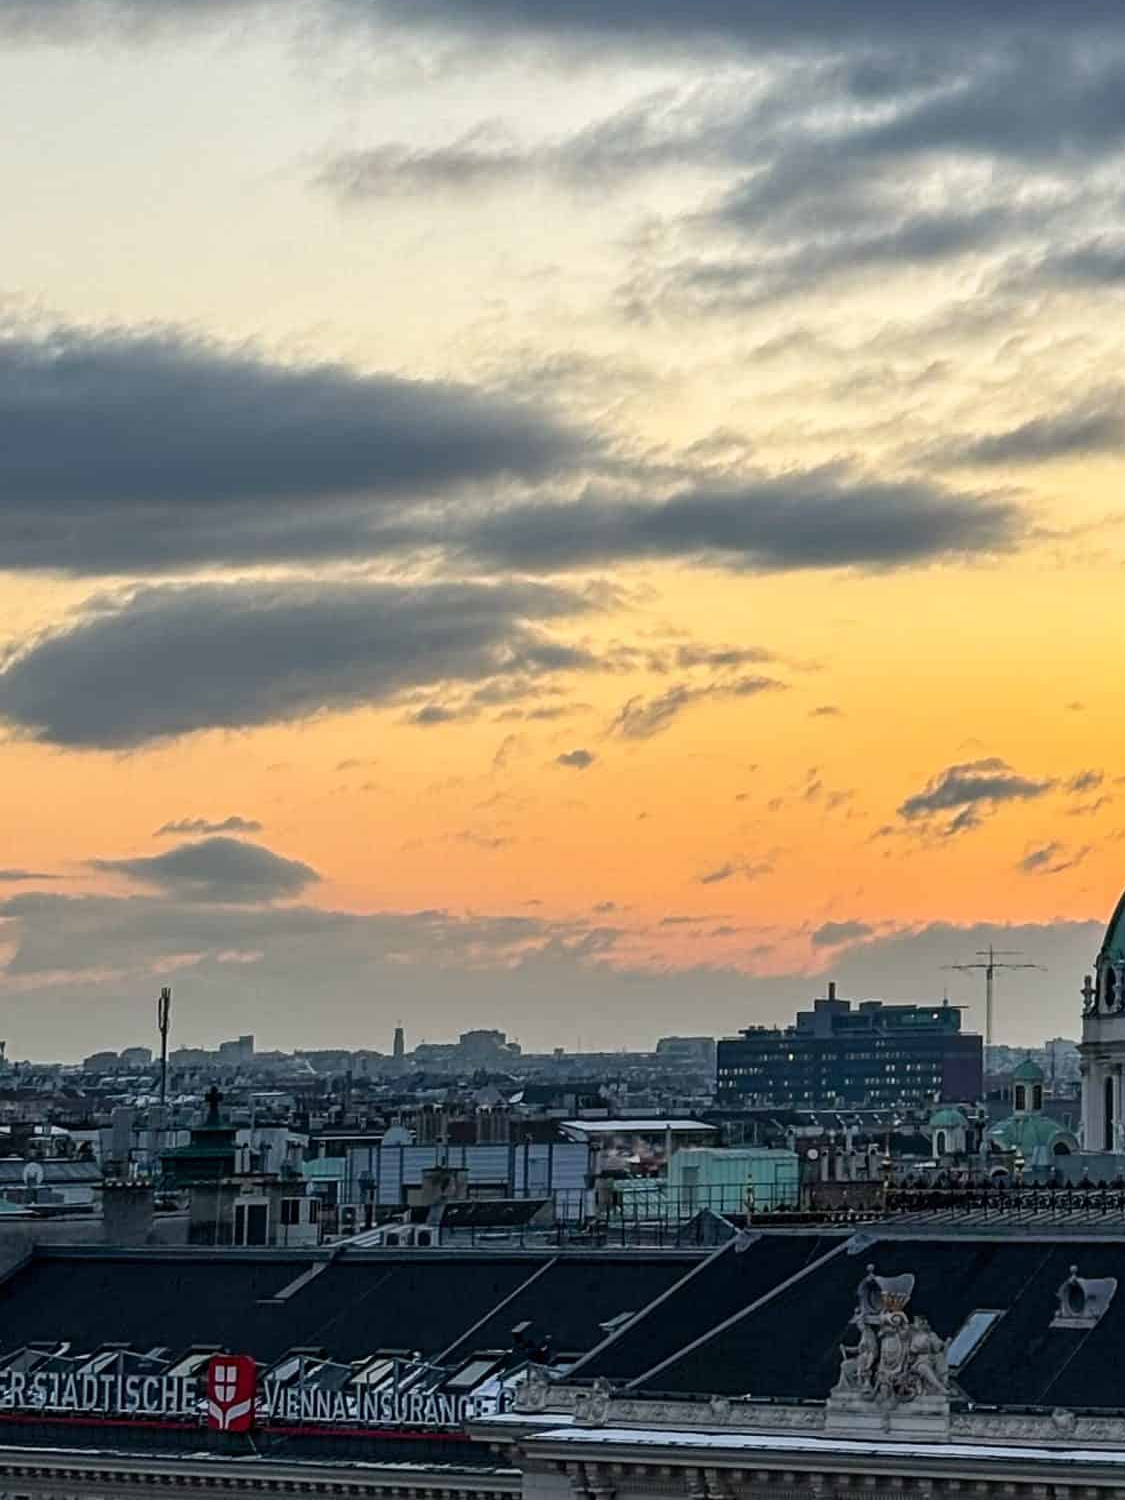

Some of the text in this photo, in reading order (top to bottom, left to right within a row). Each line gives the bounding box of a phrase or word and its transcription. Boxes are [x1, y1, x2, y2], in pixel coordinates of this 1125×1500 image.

[31, 1371, 198, 1413] STÄDTISCHE
[264, 1379, 346, 1421] VIENNA
[356, 1381, 485, 1425] INSURANCE
